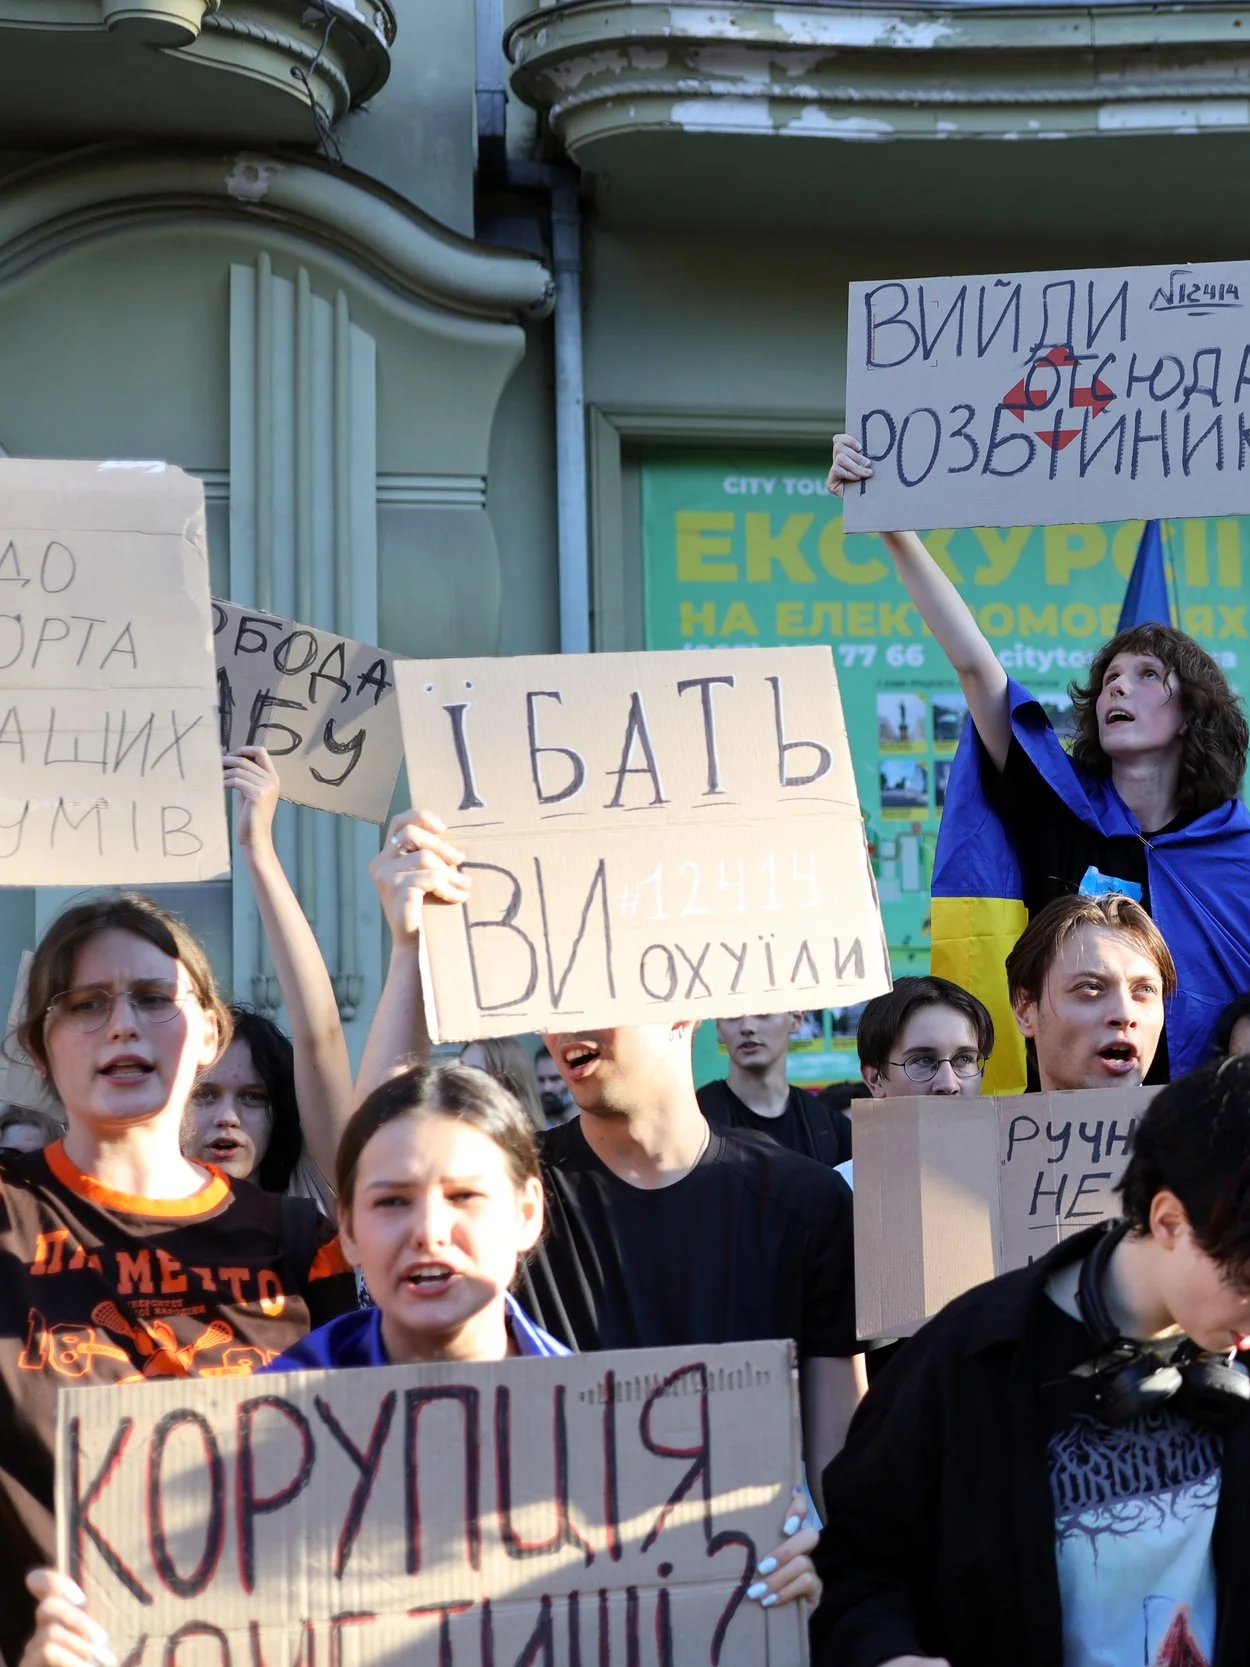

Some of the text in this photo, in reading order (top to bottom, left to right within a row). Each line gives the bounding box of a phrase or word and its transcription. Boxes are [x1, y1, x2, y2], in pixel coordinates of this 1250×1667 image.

[865, 279, 1128, 367] ВИЙДИ
[723, 476, 777, 494] CITY
[679, 602, 759, 636] НА
[839, 644, 925, 667] 77 66
[424, 675, 833, 810] ЇБАТЬ
[616, 849, 824, 920] #12414
[458, 856, 616, 1011] ВИ
[1028, 1171, 1114, 1219] НЕ
[68, 1362, 713, 1604] КОРУПЦІЯ
